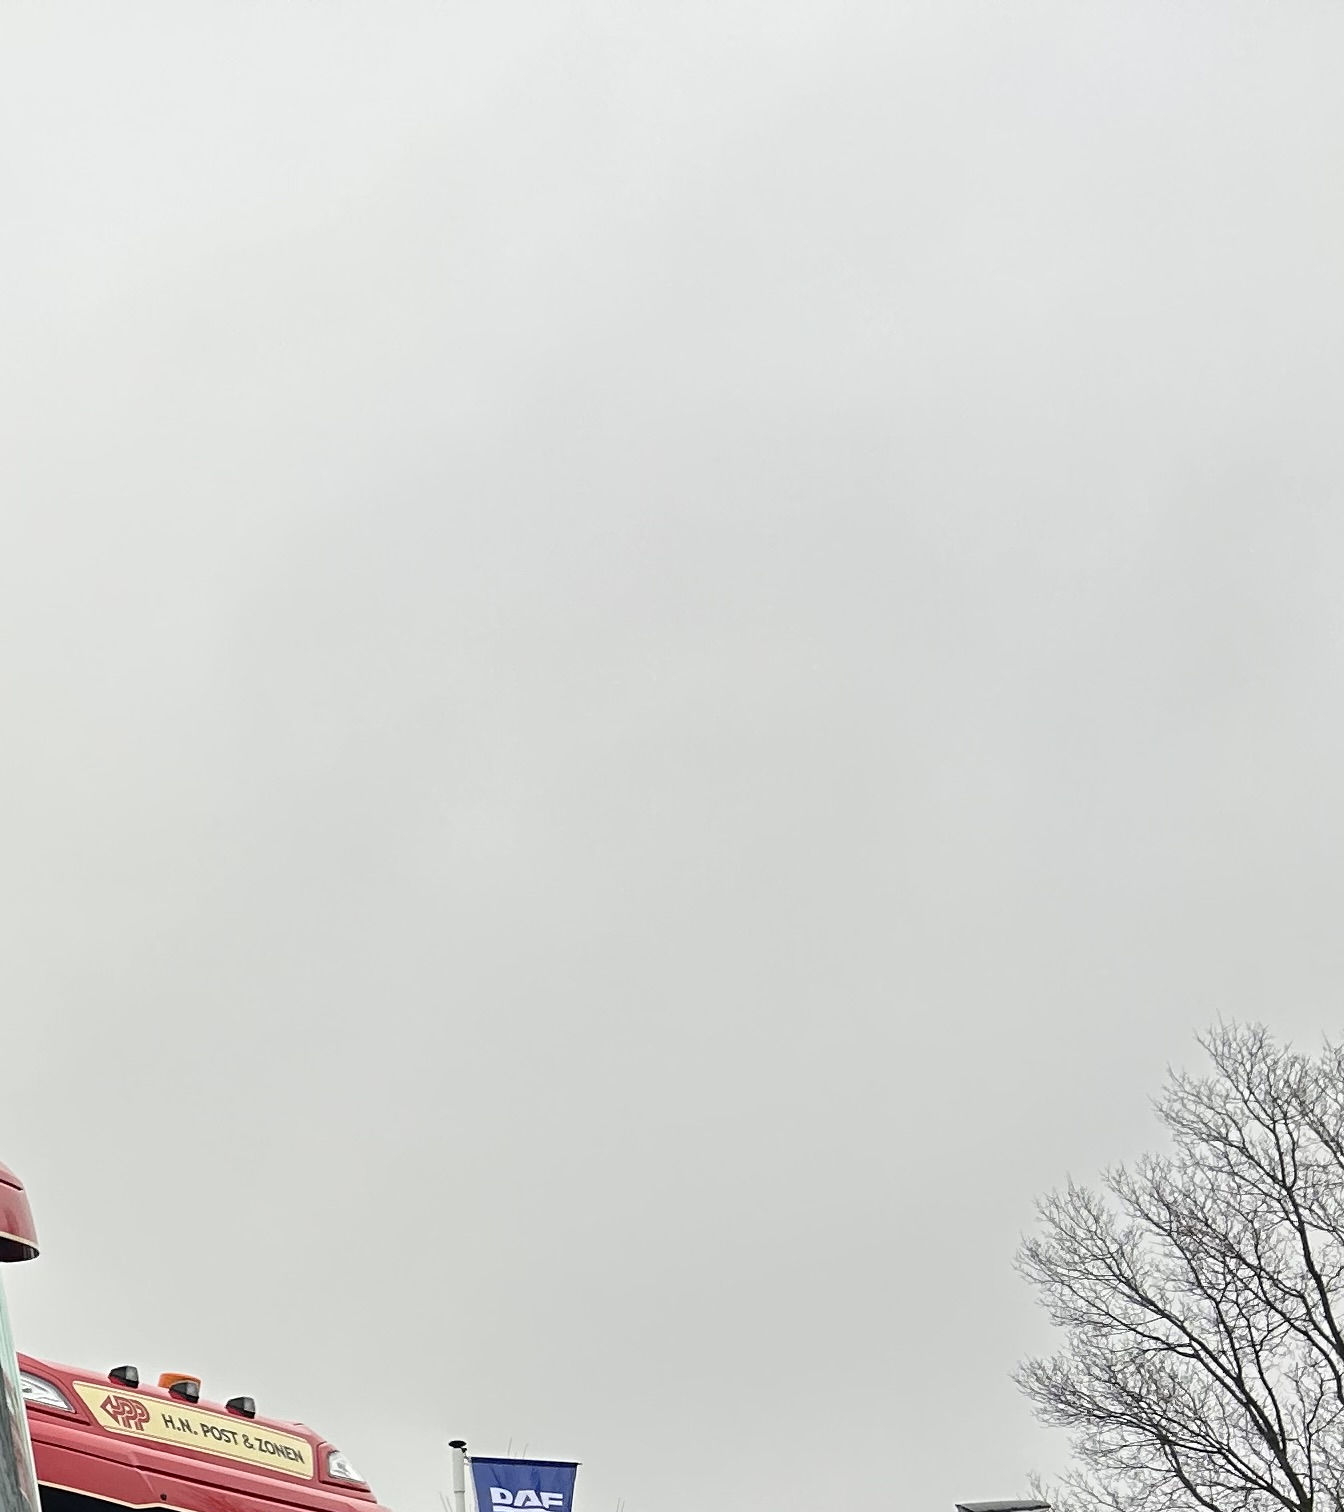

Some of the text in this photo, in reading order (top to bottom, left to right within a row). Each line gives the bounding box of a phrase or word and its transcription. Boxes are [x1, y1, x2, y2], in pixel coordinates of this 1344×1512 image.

[161, 1413, 198, 1436] H.N.
[202, 1422, 238, 1446] POST
[242, 1434, 255, 1450] &
[256, 1437, 305, 1464] ZONEN
[489, 1487, 563, 1509] DAF
